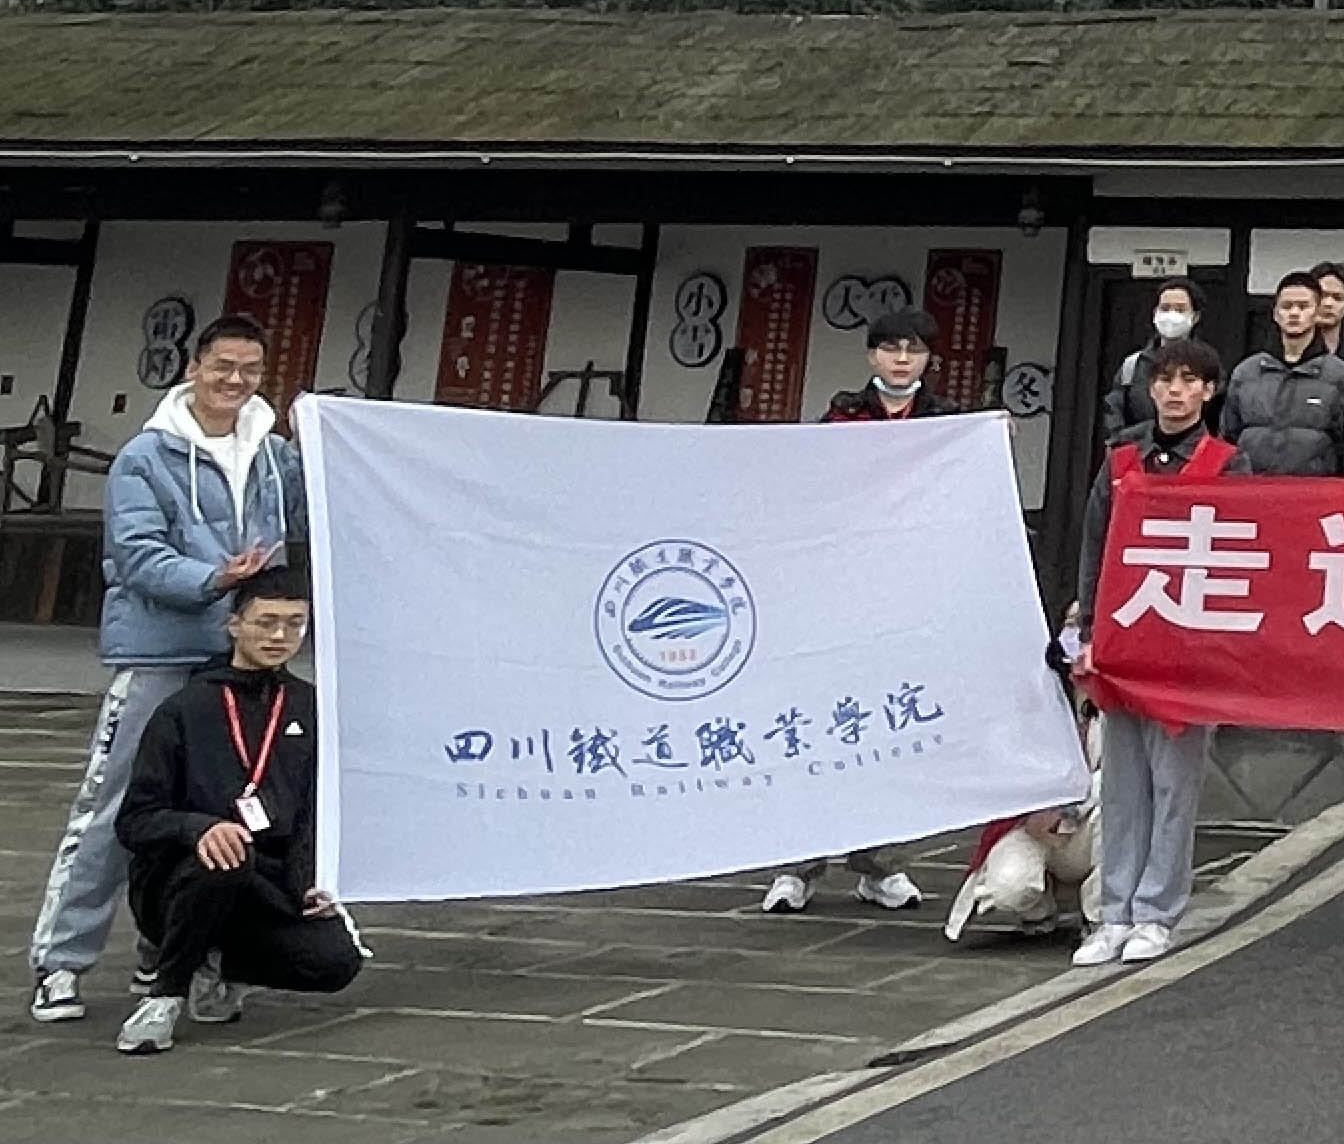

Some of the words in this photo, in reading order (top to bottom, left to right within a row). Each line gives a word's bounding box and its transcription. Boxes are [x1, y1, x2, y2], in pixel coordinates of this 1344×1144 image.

[456, 780, 598, 801] Sichuan
[630, 771, 774, 796] Railway
[806, 733, 945, 778] College
